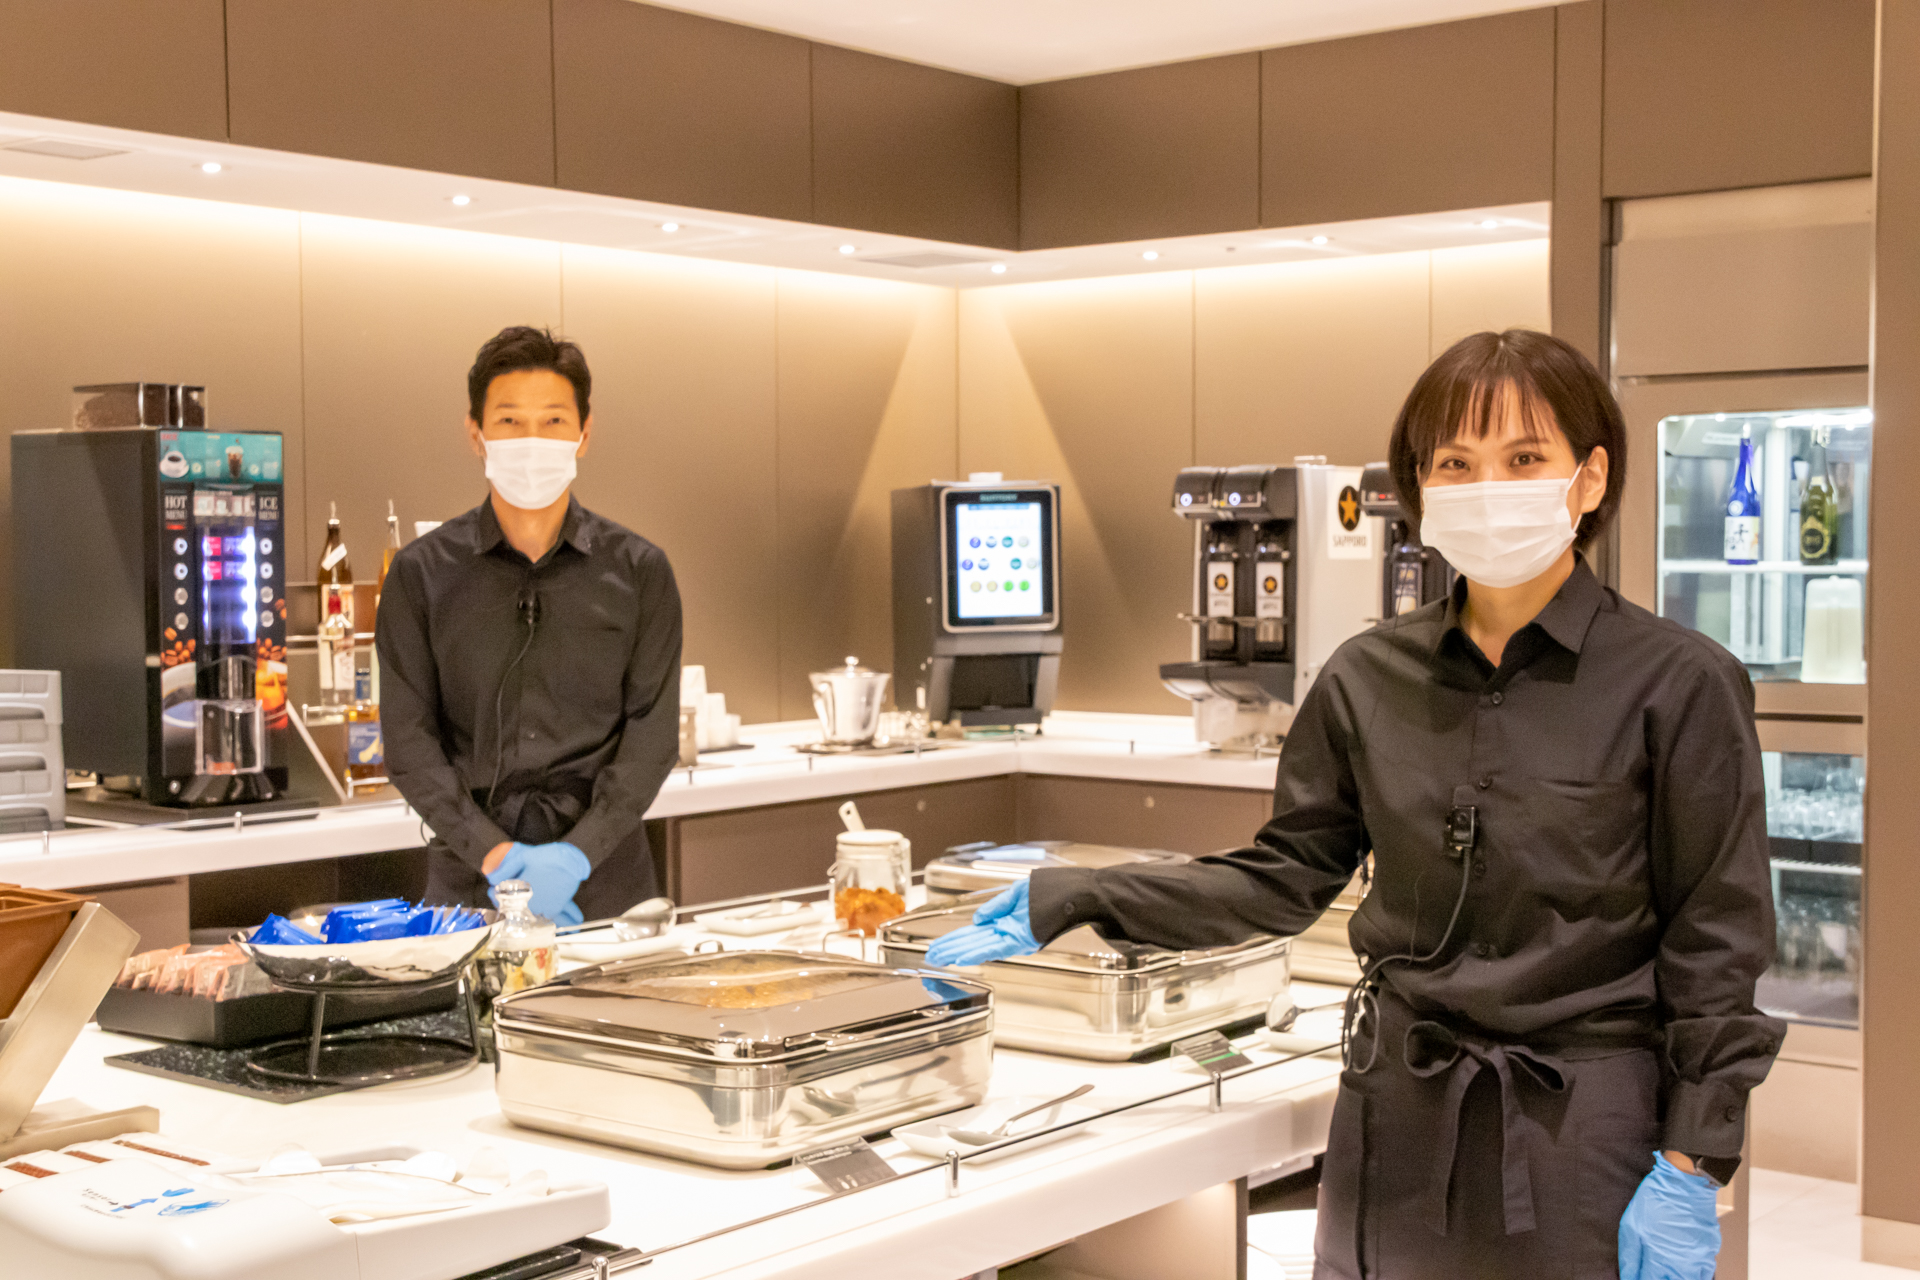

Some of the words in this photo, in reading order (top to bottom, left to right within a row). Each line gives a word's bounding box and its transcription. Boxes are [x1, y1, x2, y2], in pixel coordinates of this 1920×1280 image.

[164, 495, 188, 509] HOT
[259, 496, 279, 510] ICE
[1332, 534, 1367, 547] SAPPORO
